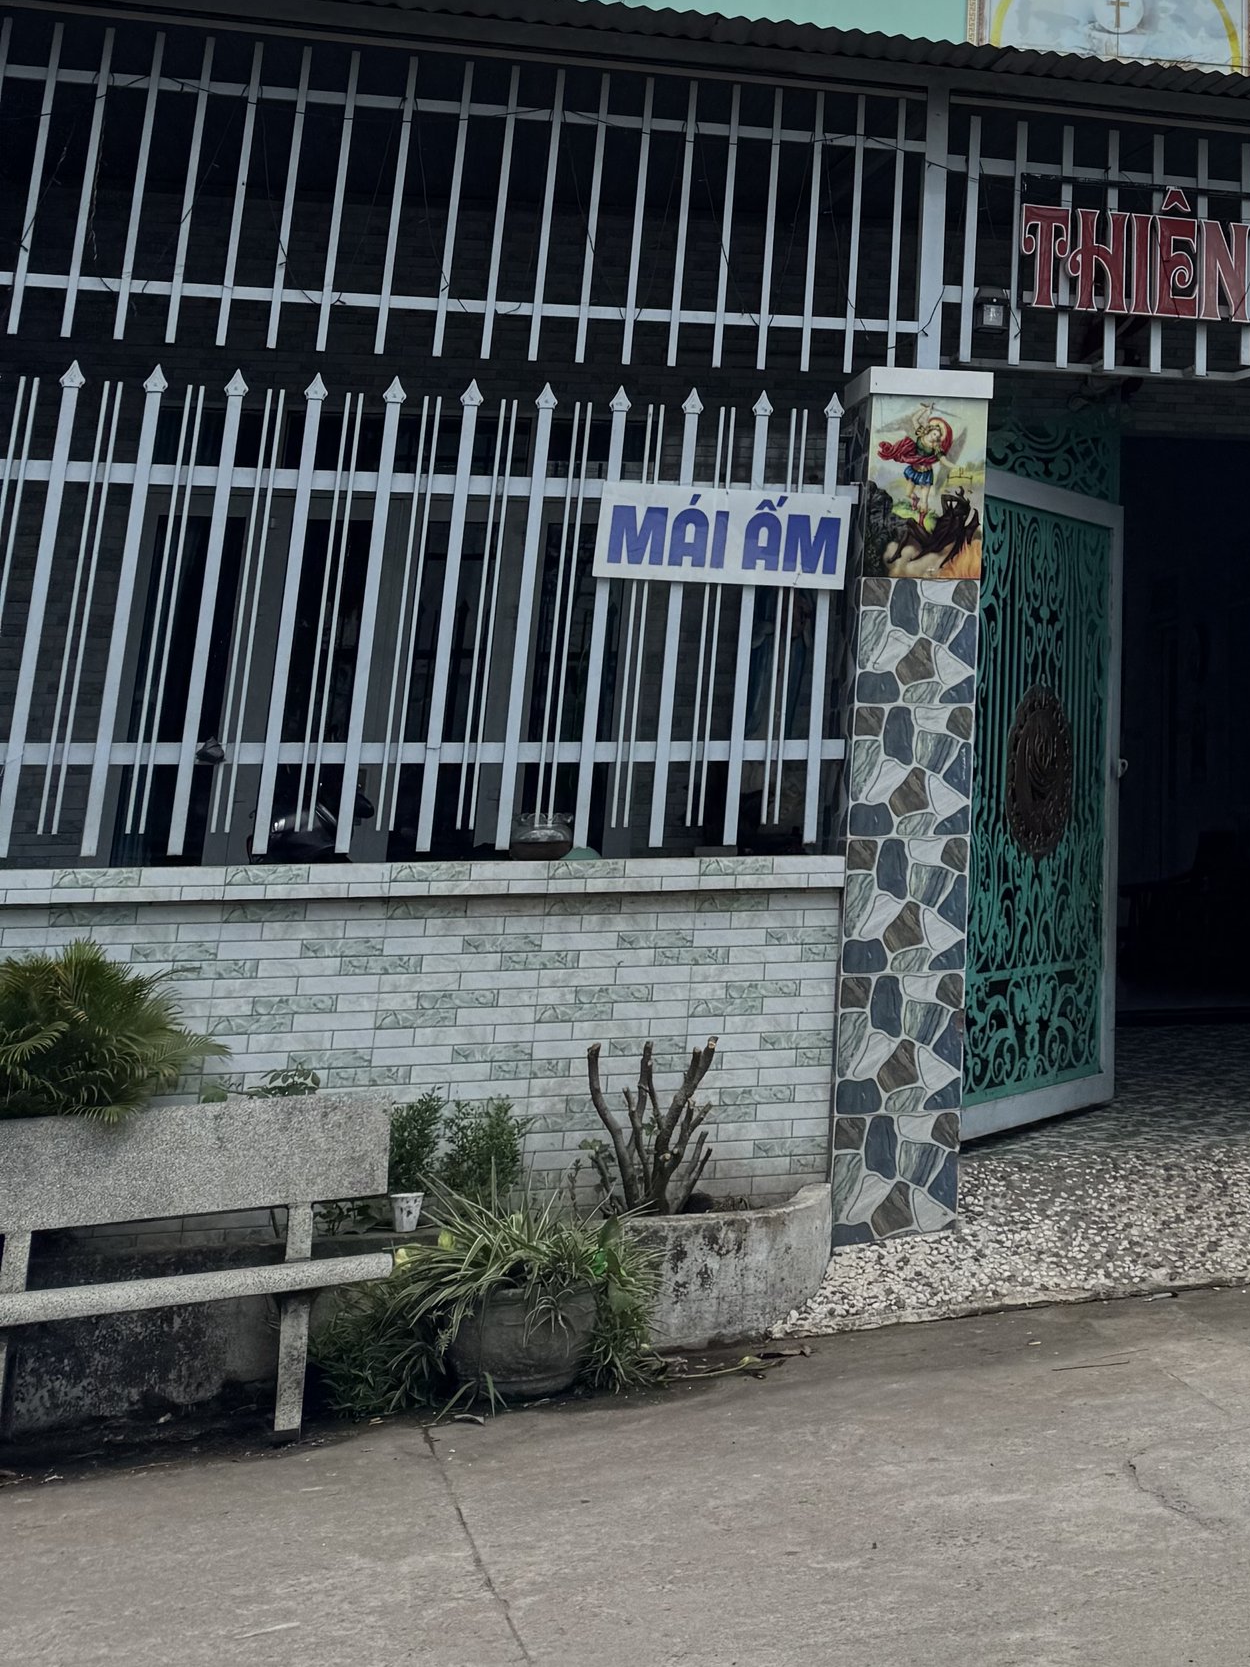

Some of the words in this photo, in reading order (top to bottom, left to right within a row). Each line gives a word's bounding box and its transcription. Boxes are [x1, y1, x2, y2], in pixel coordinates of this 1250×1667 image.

[1021, 186, 1250, 323] THIÊN
[606, 494, 729, 569] MÁI
[741, 496, 841, 575] ẤM
